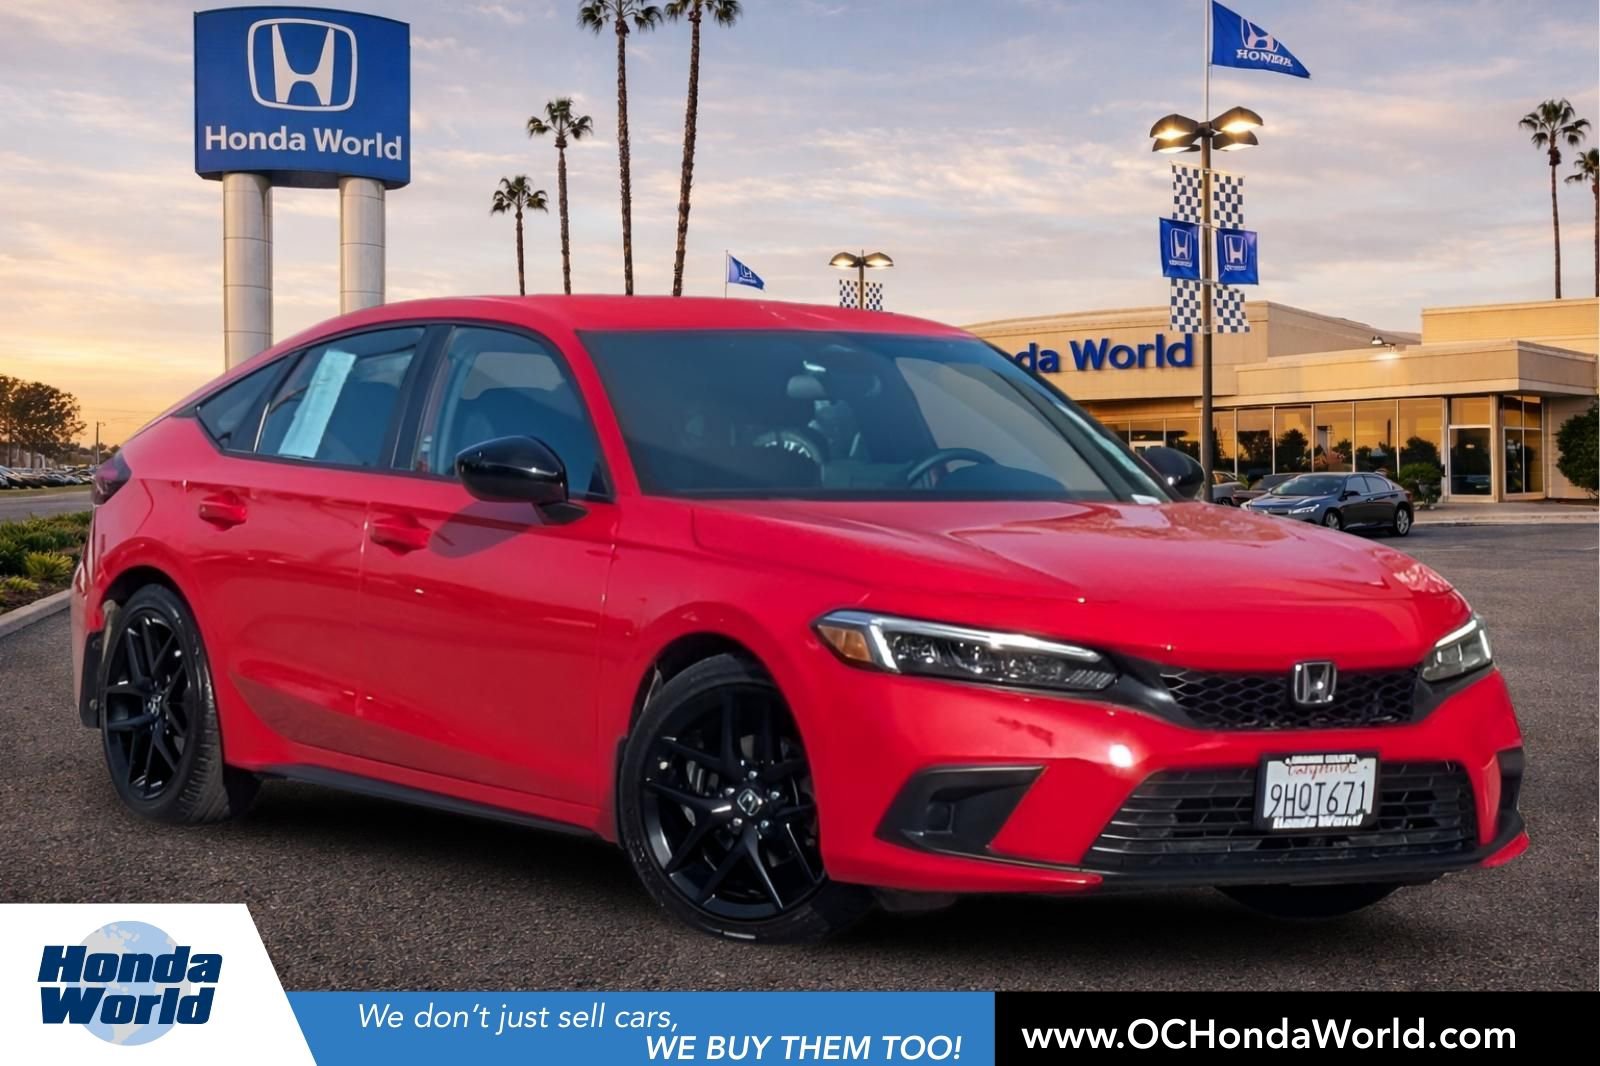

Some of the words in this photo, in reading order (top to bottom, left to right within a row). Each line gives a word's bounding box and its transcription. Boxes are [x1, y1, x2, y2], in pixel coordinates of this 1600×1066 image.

[205, 125, 306, 151] Honda
[313, 127, 402, 161] World
[1069, 333, 1193, 371] World
